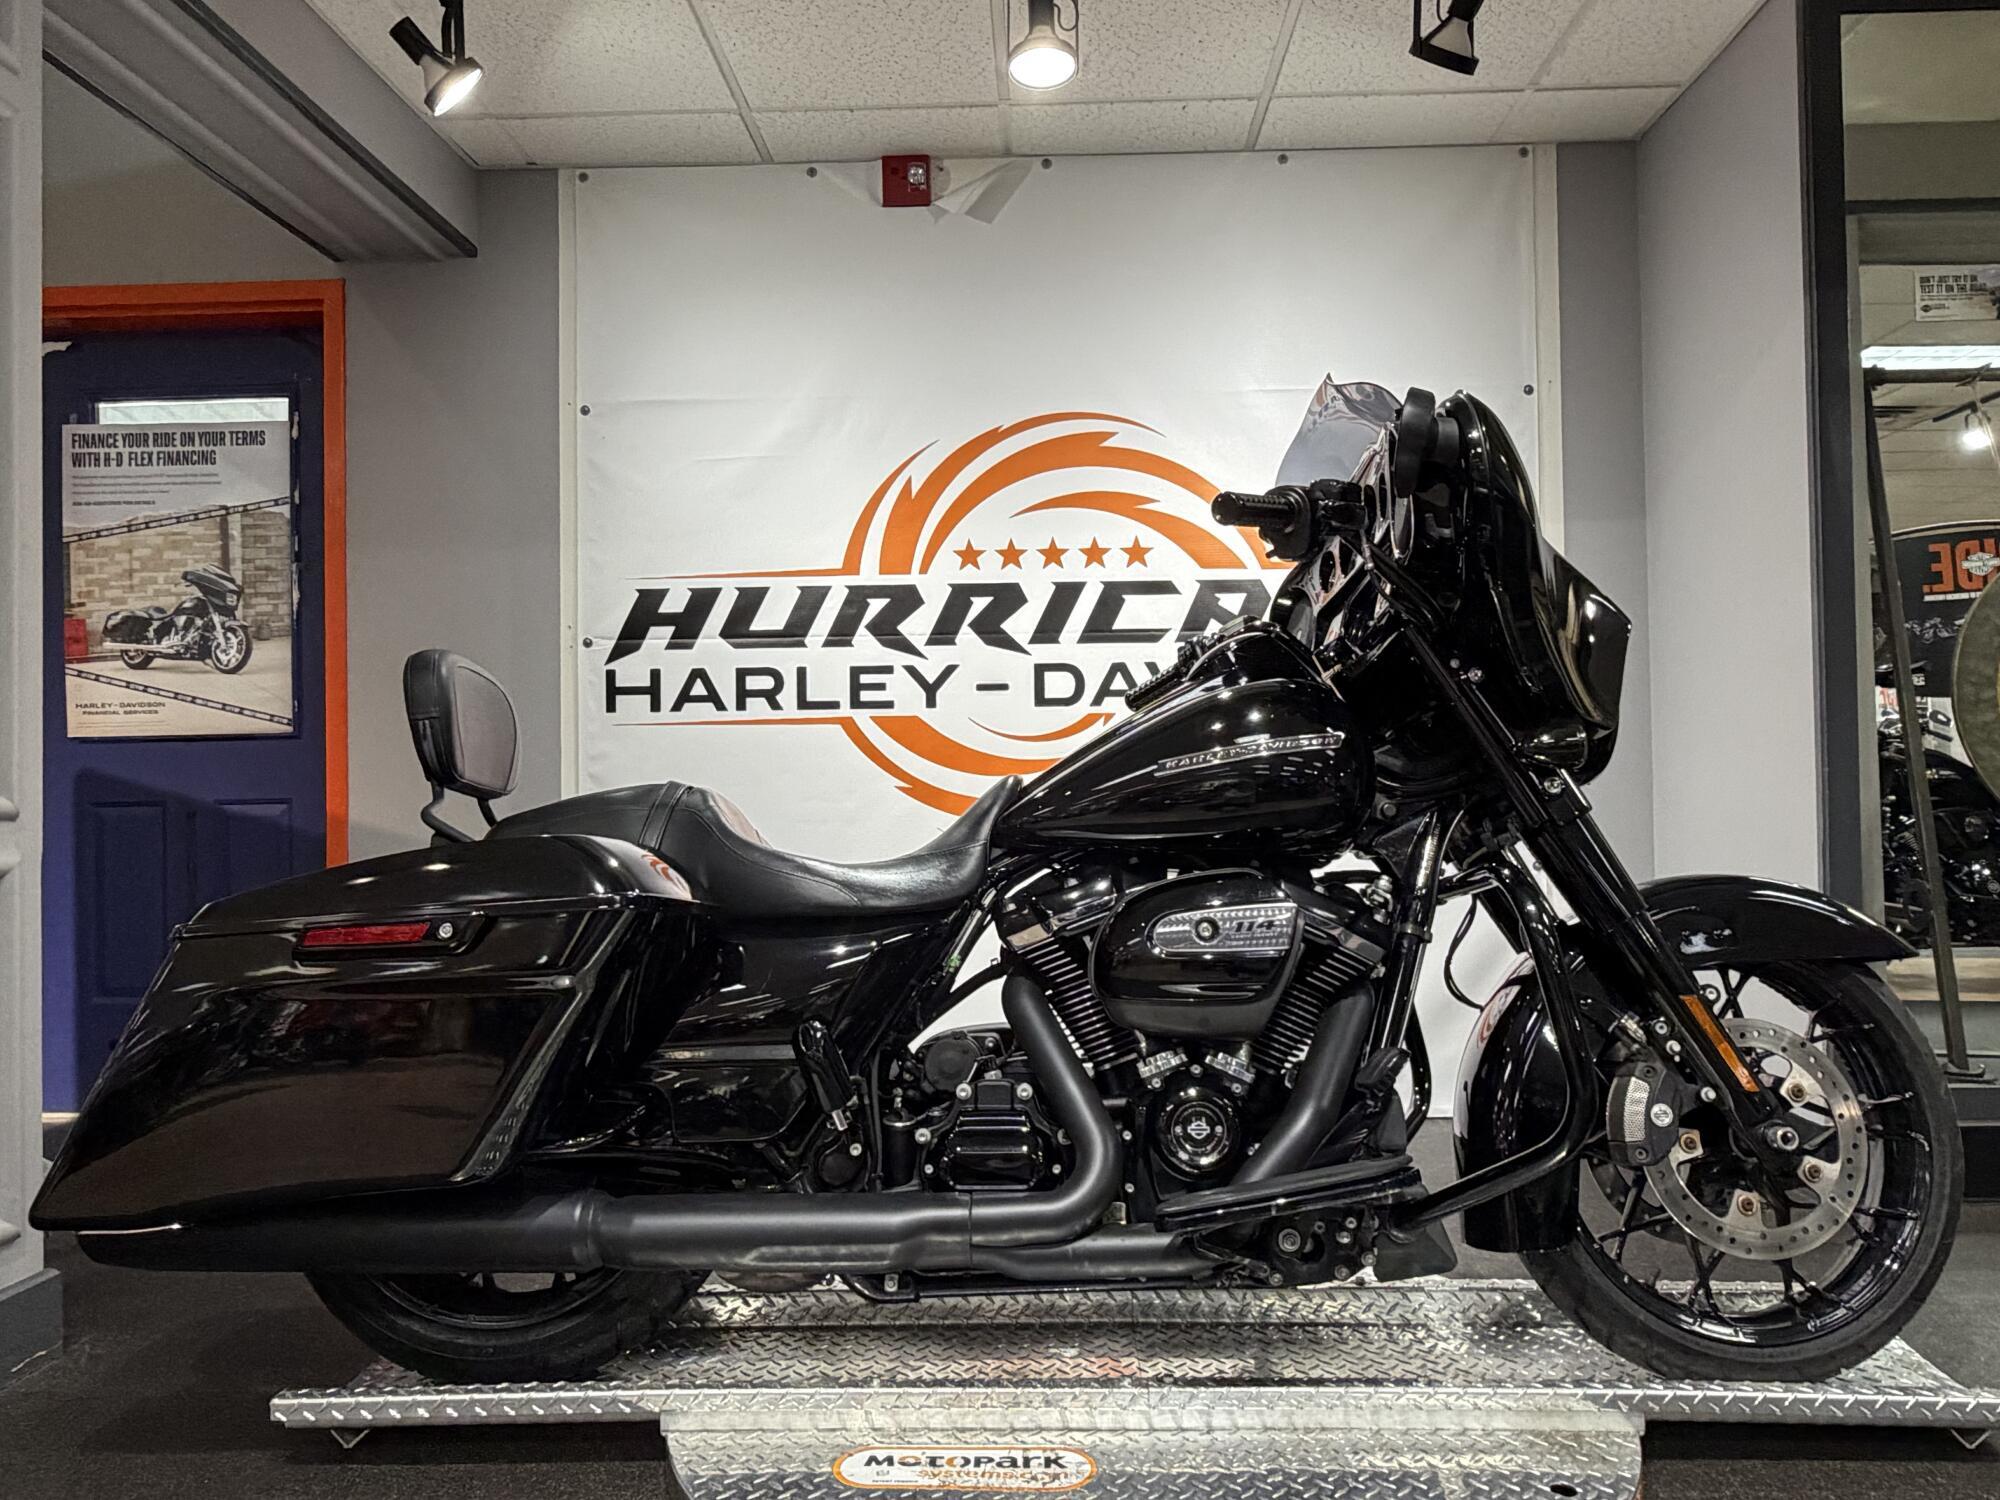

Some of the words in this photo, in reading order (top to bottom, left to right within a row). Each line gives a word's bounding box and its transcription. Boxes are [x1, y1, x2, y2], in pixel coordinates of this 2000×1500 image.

[71, 432, 119, 449] FINANCE
[121, 432, 149, 449] YOUR
[152, 431, 177, 448] RIDE
[180, 431, 195, 448] ON
[198, 431, 226, 448] YOUR
[228, 430, 266, 447] TERMS
[71, 451, 100, 468] WITH
[128, 450, 154, 467] FLEX
[156, 449, 217, 466] FINANCING
[1233, 920, 1277, 933] 114
